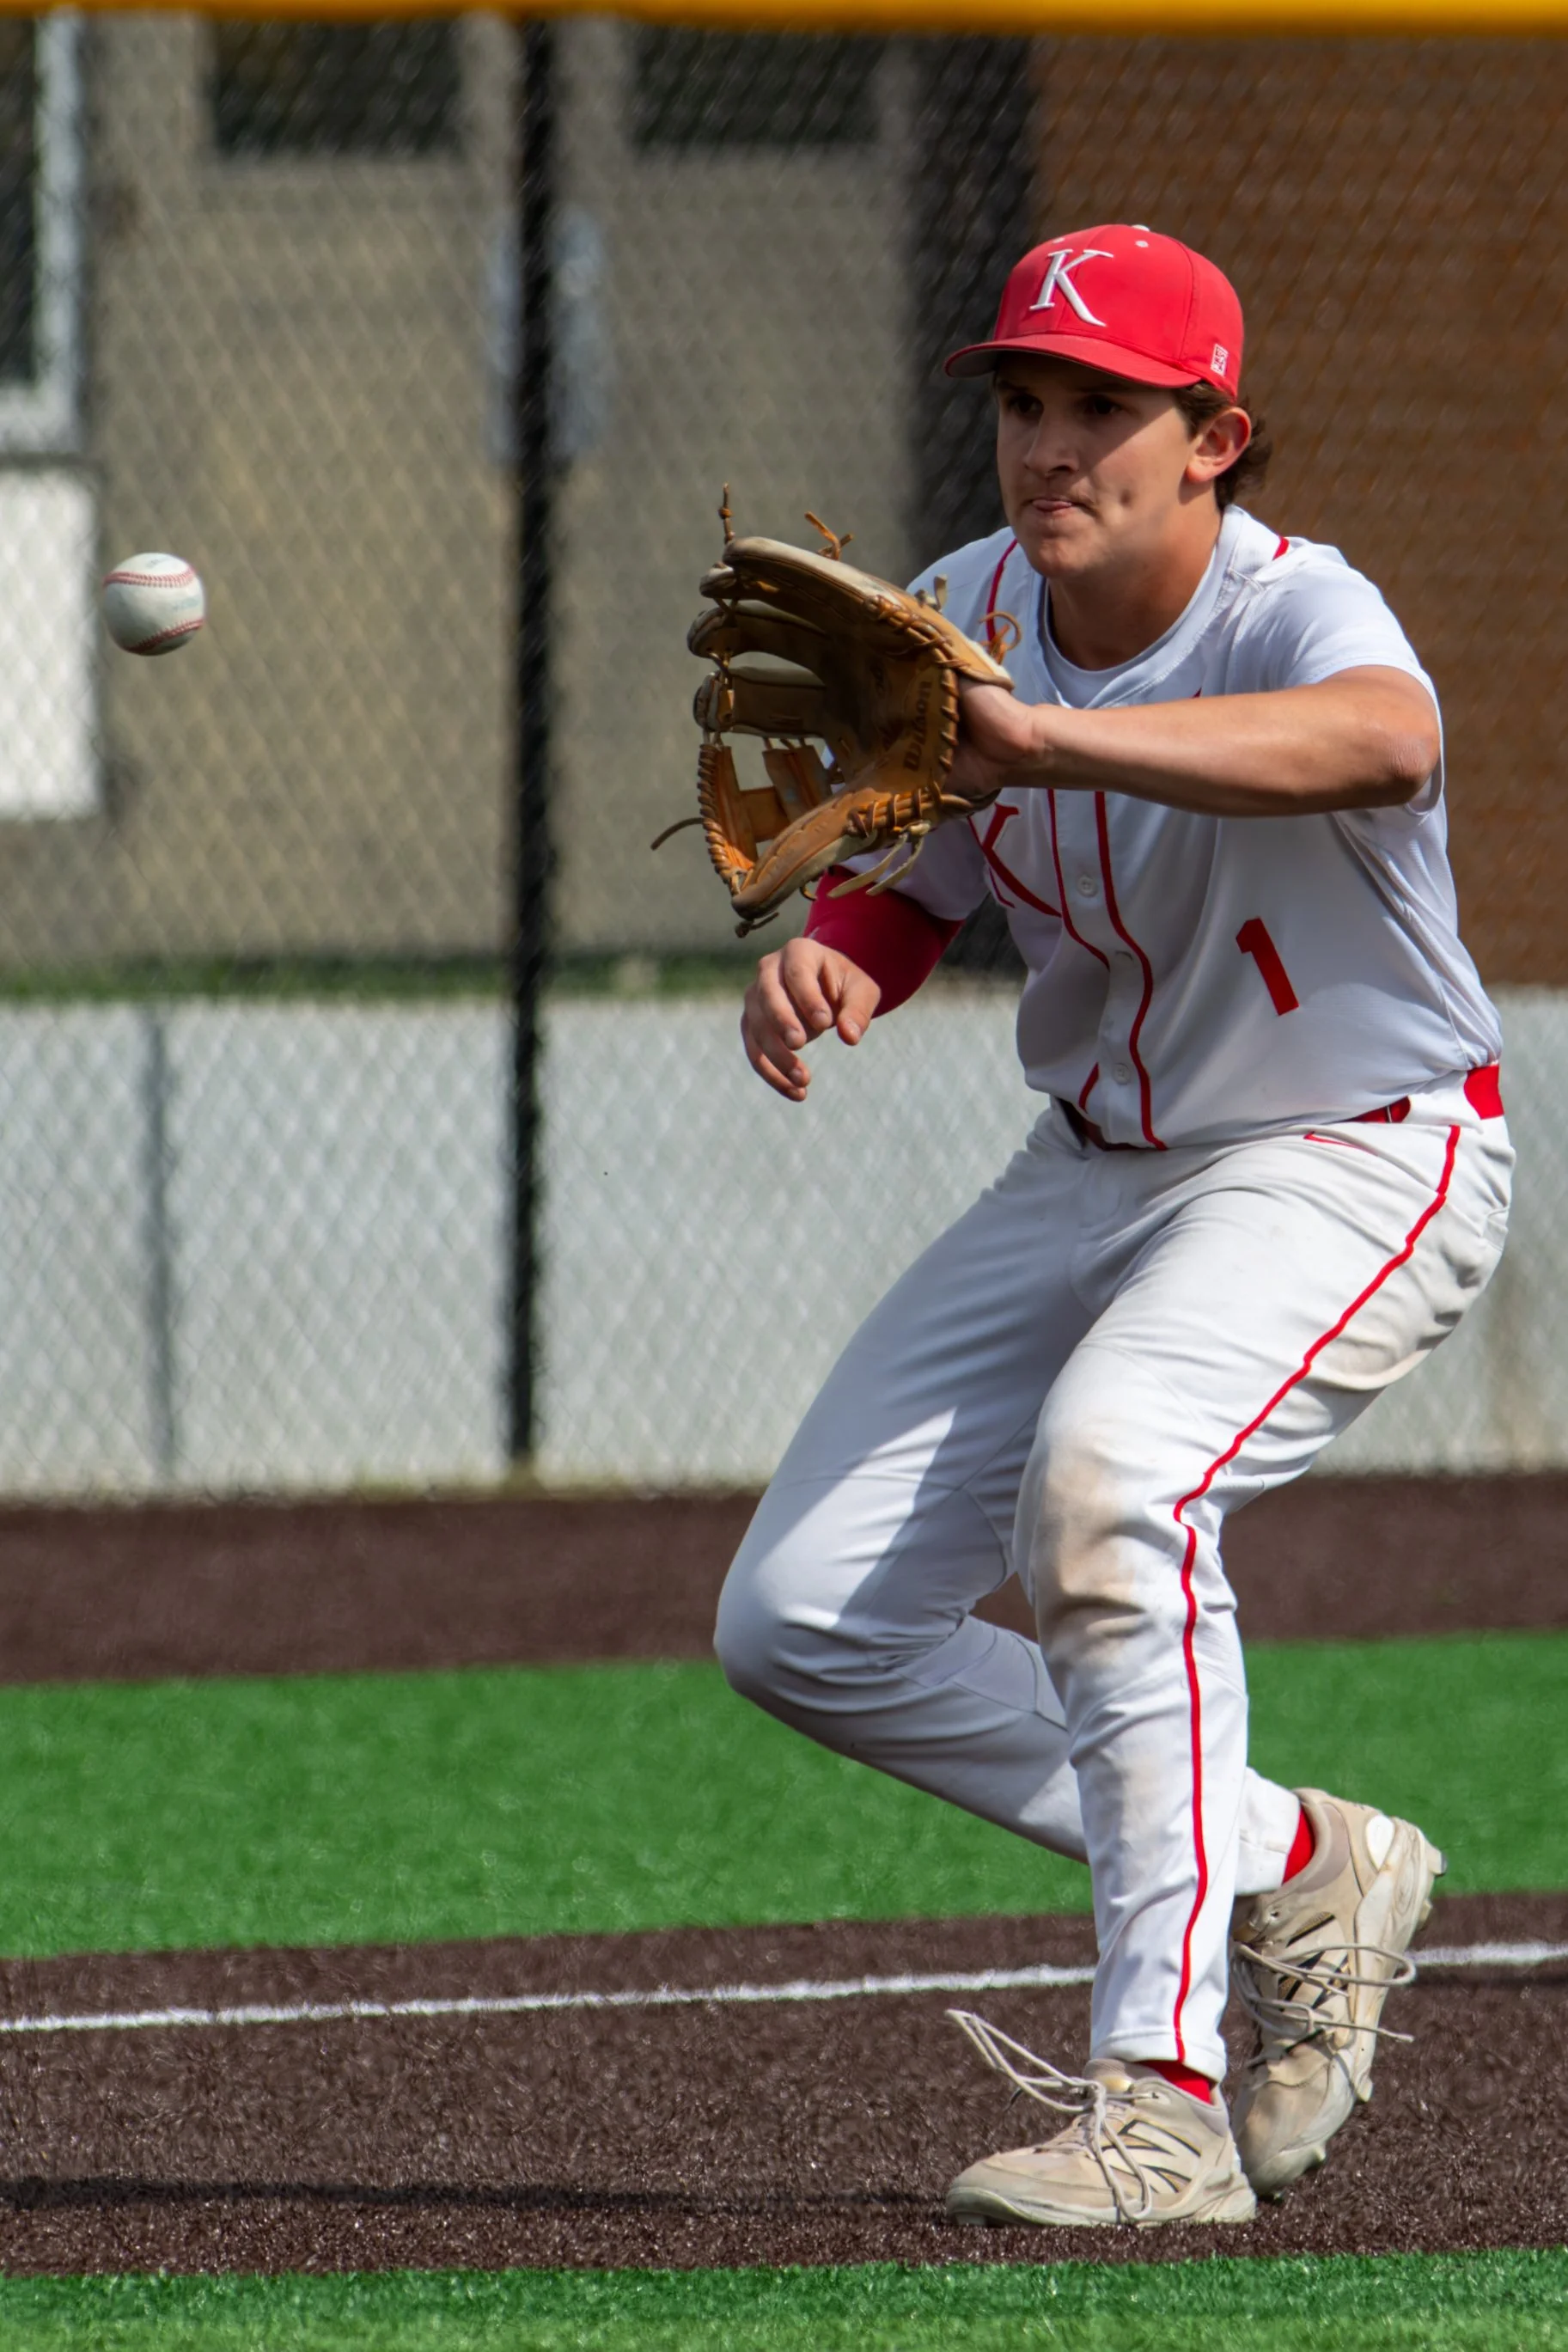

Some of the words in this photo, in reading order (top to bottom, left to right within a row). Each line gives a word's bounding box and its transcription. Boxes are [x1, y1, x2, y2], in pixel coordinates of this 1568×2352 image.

[1029, 249, 1113, 327] K
[904, 681, 932, 771] Wilson
[967, 803, 1063, 917] K
[1235, 916, 1300, 1016] 1
